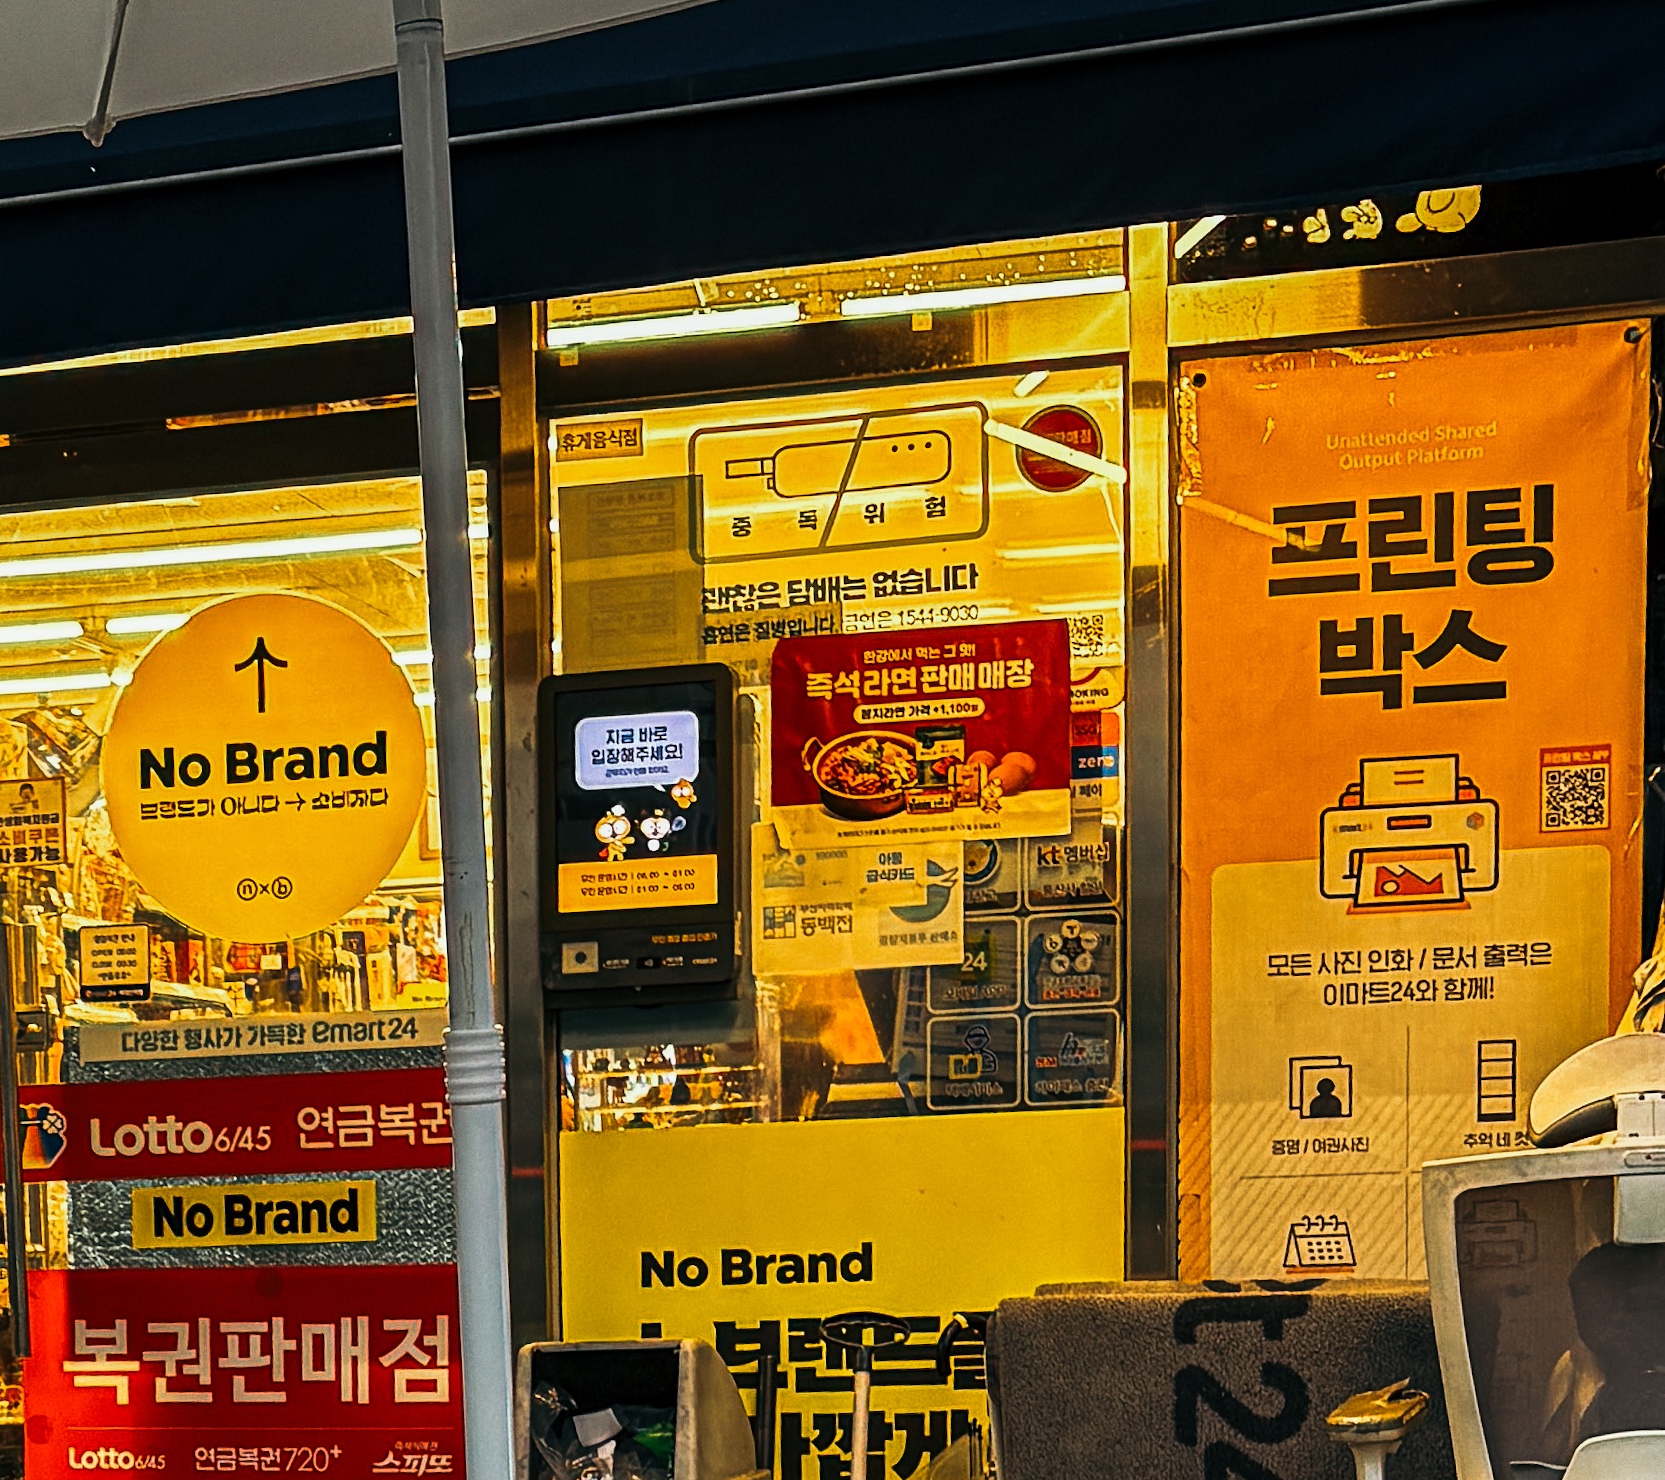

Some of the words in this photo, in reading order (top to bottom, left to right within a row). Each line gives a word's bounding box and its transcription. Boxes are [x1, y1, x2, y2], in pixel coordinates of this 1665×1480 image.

[562, 429, 637, 451] 휴게음식점
[1326, 426, 1430, 449] Unattended
[1435, 420, 1497, 441] Shared
[1339, 451, 1401, 471] Output
[1407, 446, 1484, 465] Platform
[1268, 484, 1555, 598] 프린팅
[788, 575, 866, 608] 담배는
[873, 563, 979, 598] 없습니다
[1319, 609, 1508, 710] 박스
[606, 728, 634, 744] 지금
[639, 726, 668, 742] 바로
[140, 747, 211, 789] No
[226, 730, 387, 784] Brand
[220, 795, 280, 816] 아니다
[800, 915, 853, 937] 동백전
[1267, 953, 1312, 977] 모든
[1318, 951, 1362, 976] 사진
[1367, 948, 1414, 973] 인화
[1432, 946, 1477, 970] 문서
[1483, 942, 1552, 967] 출력은
[1323, 979, 1437, 1006] 이마트24와
[1444, 977, 1494, 1001] 함께!
[121, 1030, 179, 1053] 다양한
[184, 1027, 243, 1050] 행사가
[247, 1023, 306, 1046] 가득한
[311, 1017, 419, 1044] emart24
[152, 1196, 212, 1239] No
[224, 1188, 360, 1236] Brand
[640, 1250, 709, 1288] No
[721, 1242, 873, 1286] Brand
[62, 1315, 451, 1406] 복권판매점
[372, 1453, 454, 1477] 스피또
